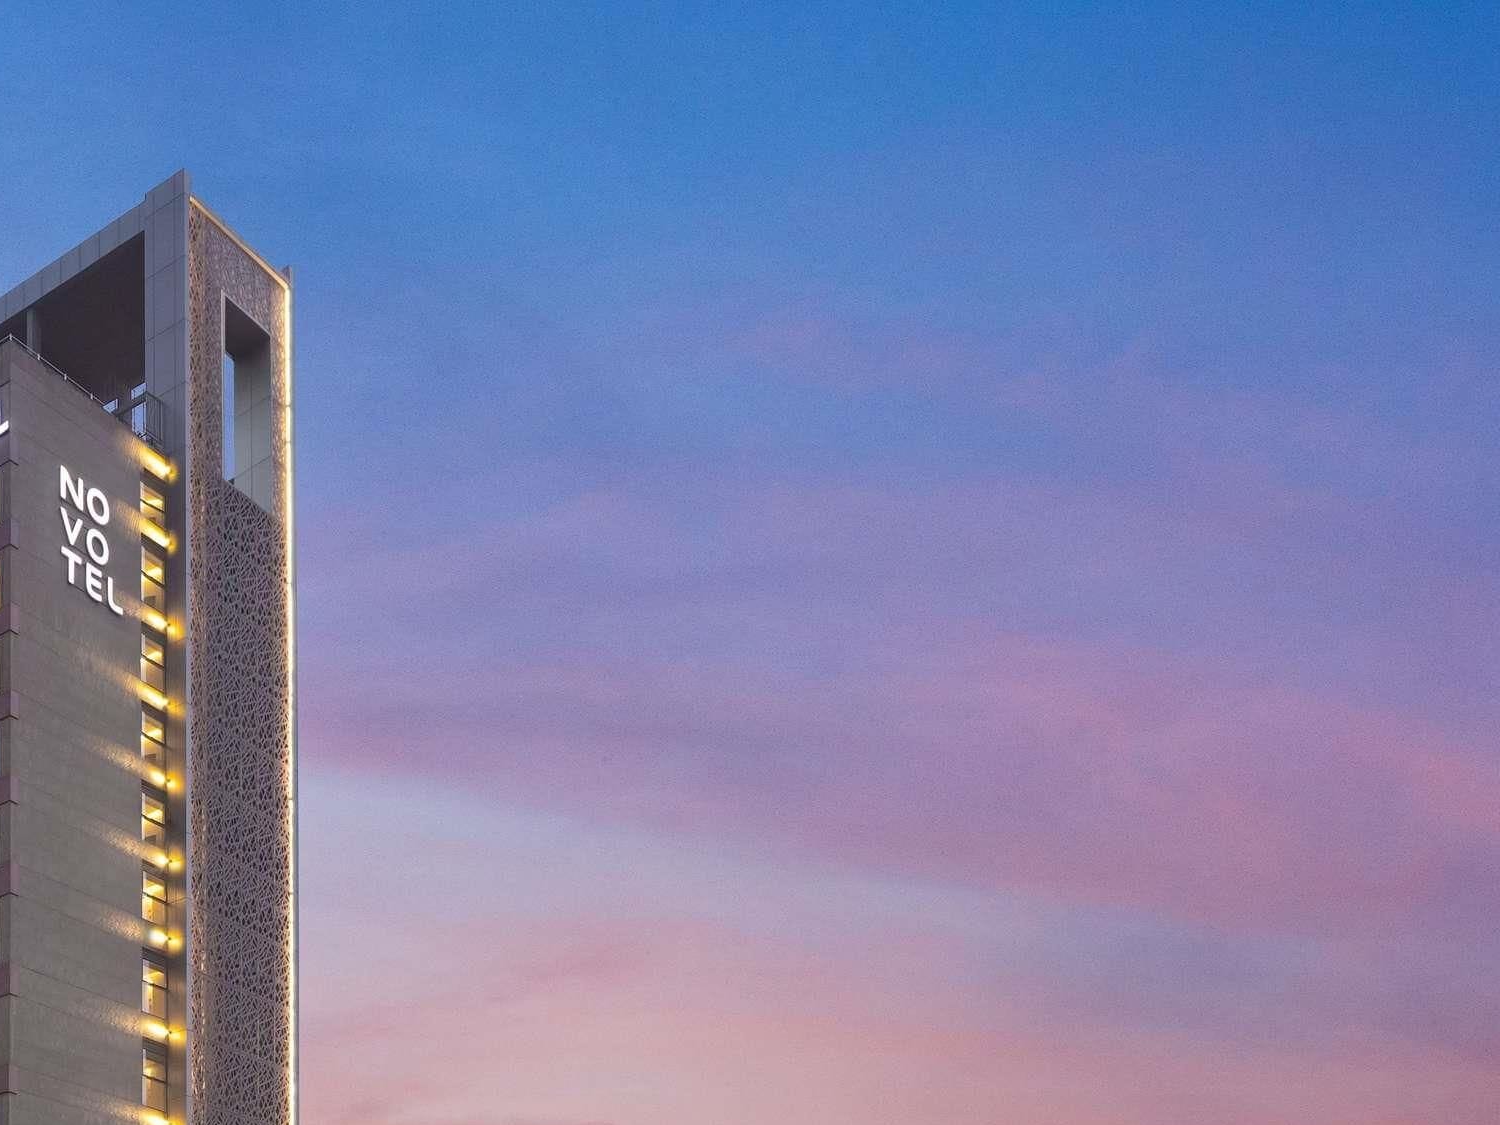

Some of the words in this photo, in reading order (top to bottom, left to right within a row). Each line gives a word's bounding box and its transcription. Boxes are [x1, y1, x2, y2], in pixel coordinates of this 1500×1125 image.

[59, 464, 110, 526] NO
[59, 506, 110, 566] VO
[60, 545, 124, 616] TEL
